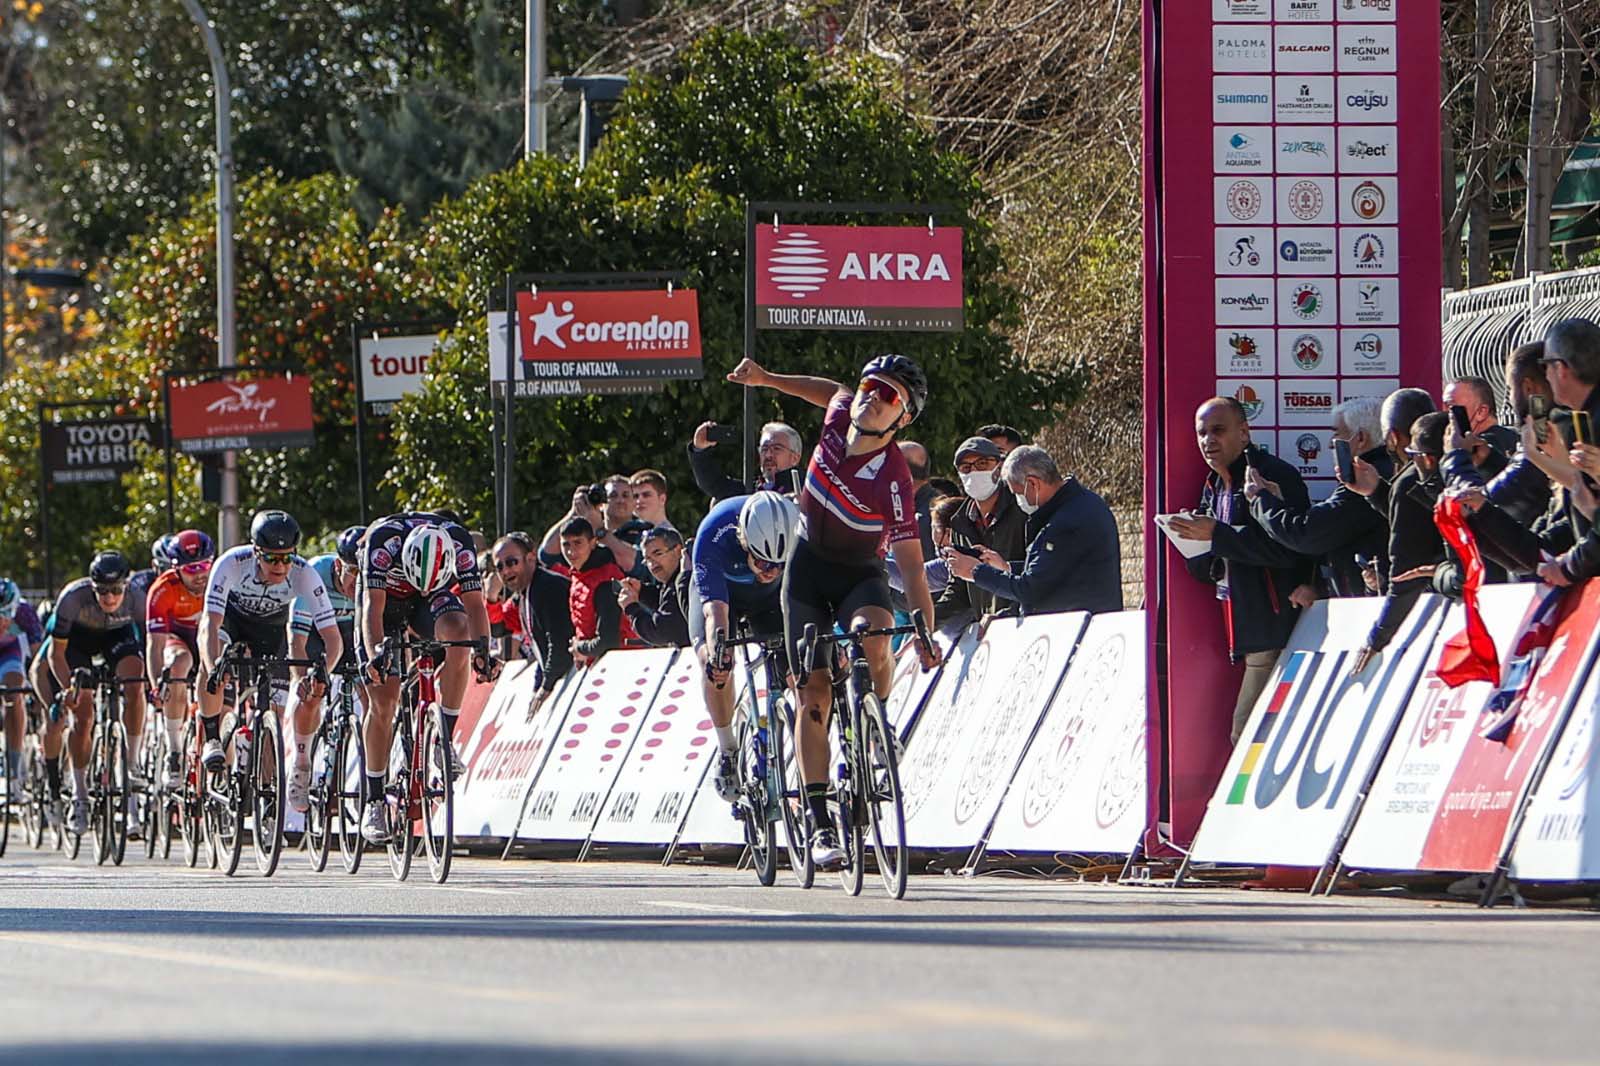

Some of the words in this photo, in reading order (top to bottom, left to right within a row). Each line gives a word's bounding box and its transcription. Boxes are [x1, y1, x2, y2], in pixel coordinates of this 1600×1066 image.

[1288, 11, 1320, 19] HOTELS
[1218, 39, 1266, 47] PALOMA
[1344, 47, 1390, 55] REGNUM
[1217, 94, 1268, 104] SHIMANO
[839, 252, 950, 281] AKRA
[768, 308, 800, 325] TOUR
[801, 308, 816, 325] OF
[816, 309, 866, 326] ANTALYA
[571, 314, 689, 343] corendon
[626, 340, 689, 351] AIRLINES
[532, 362, 561, 377] TOUR
[562, 362, 575, 376] OF
[576, 361, 619, 376] ANTALYA
[527, 381, 540, 396] OF
[540, 380, 582, 396] ANTALYA
[1284, 393, 1332, 407] TÜRSAB
[65, 423, 150, 445] TOYOTA
[712, 523, 735, 543] wahoo
[1254, 650, 1407, 810] UCI
